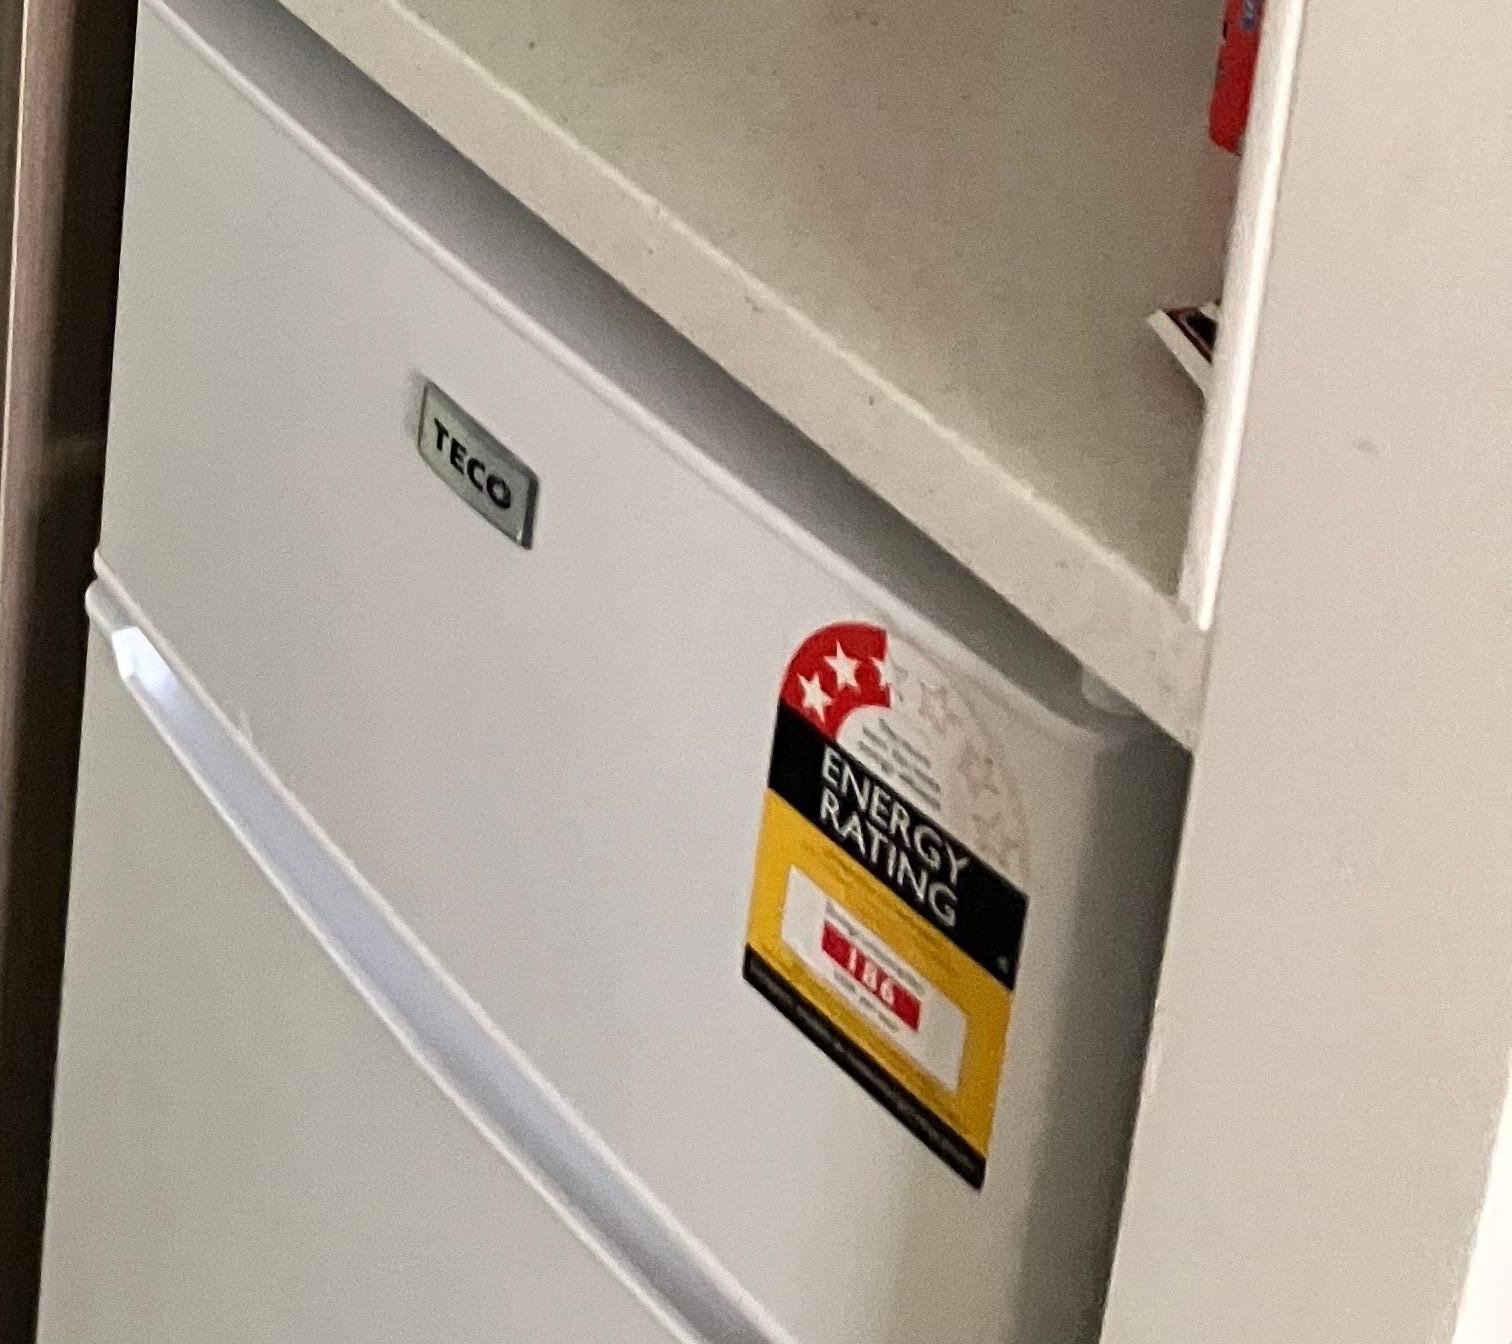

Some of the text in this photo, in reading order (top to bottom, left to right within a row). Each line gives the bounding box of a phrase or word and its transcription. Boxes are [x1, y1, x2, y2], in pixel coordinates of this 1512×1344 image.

[433, 417, 512, 510] TECO
[821, 788, 958, 927] RATING
[822, 746, 970, 885] ENERGY
